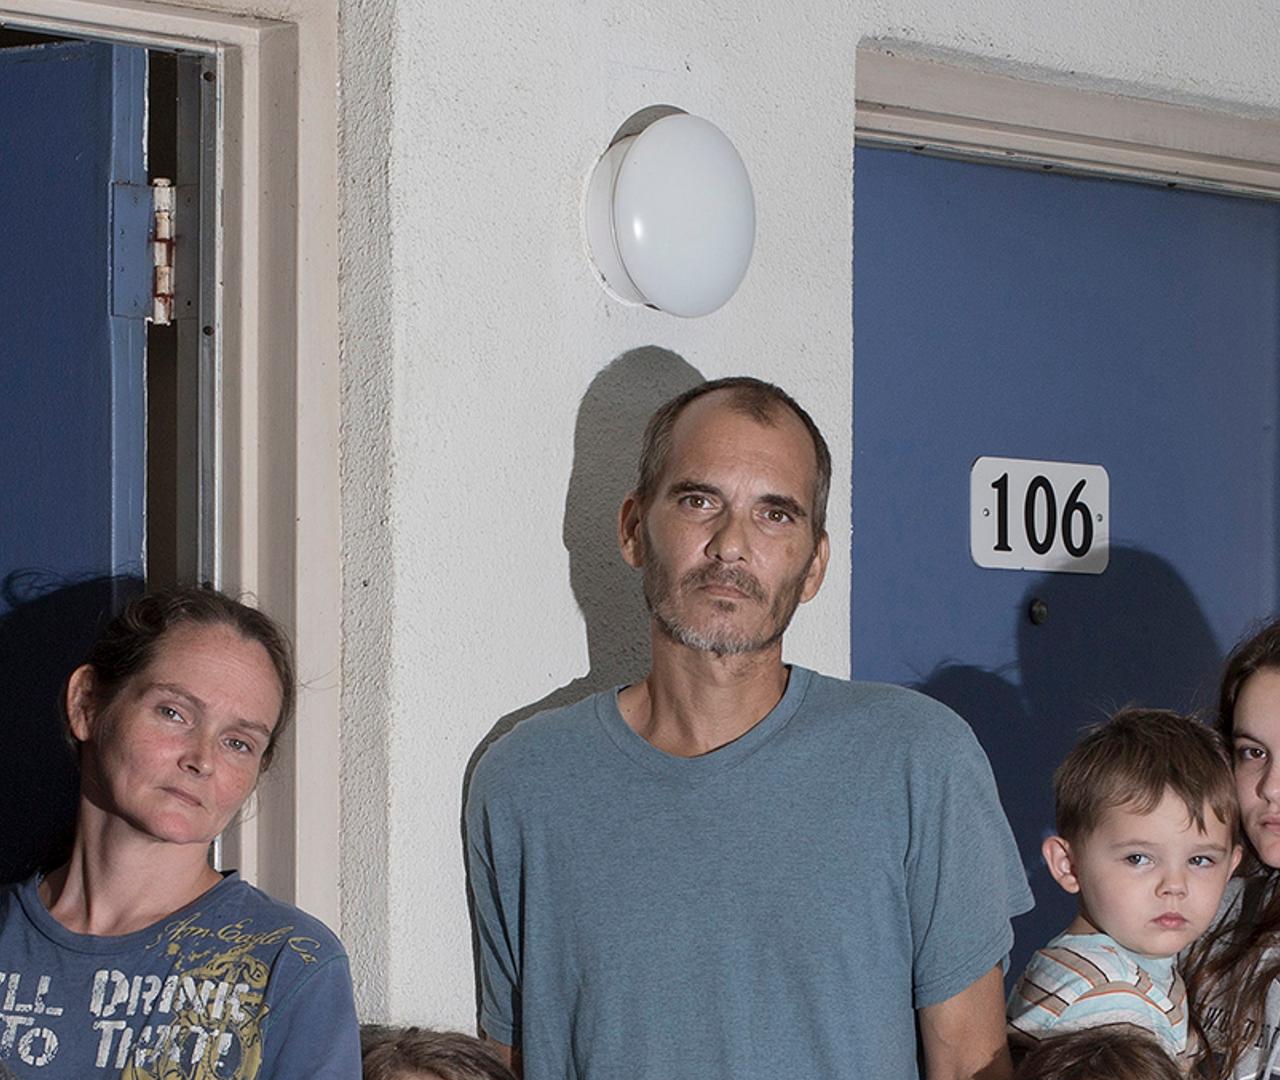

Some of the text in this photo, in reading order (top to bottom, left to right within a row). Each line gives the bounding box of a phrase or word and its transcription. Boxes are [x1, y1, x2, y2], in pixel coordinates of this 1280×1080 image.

[991, 472, 1094, 558] 106
[89, 969, 250, 1022] DRINK
[93, 1020, 233, 1068] THAT!
